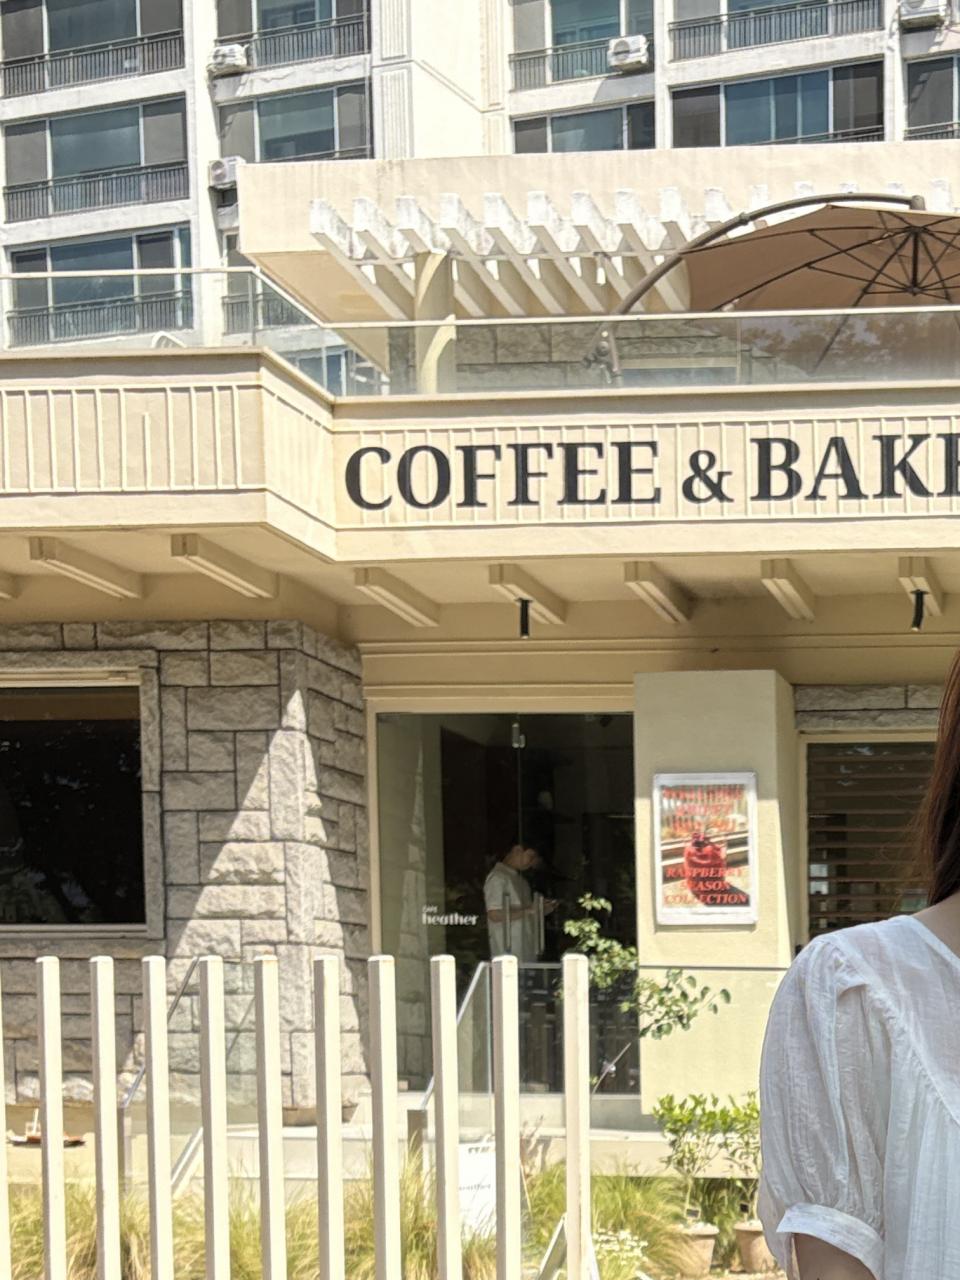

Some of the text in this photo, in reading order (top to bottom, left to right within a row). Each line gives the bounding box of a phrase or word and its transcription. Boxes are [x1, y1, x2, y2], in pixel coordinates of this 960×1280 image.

[345, 440, 662, 511] COFFEE
[681, 448, 735, 504] &
[422, 912, 478, 926] heather
